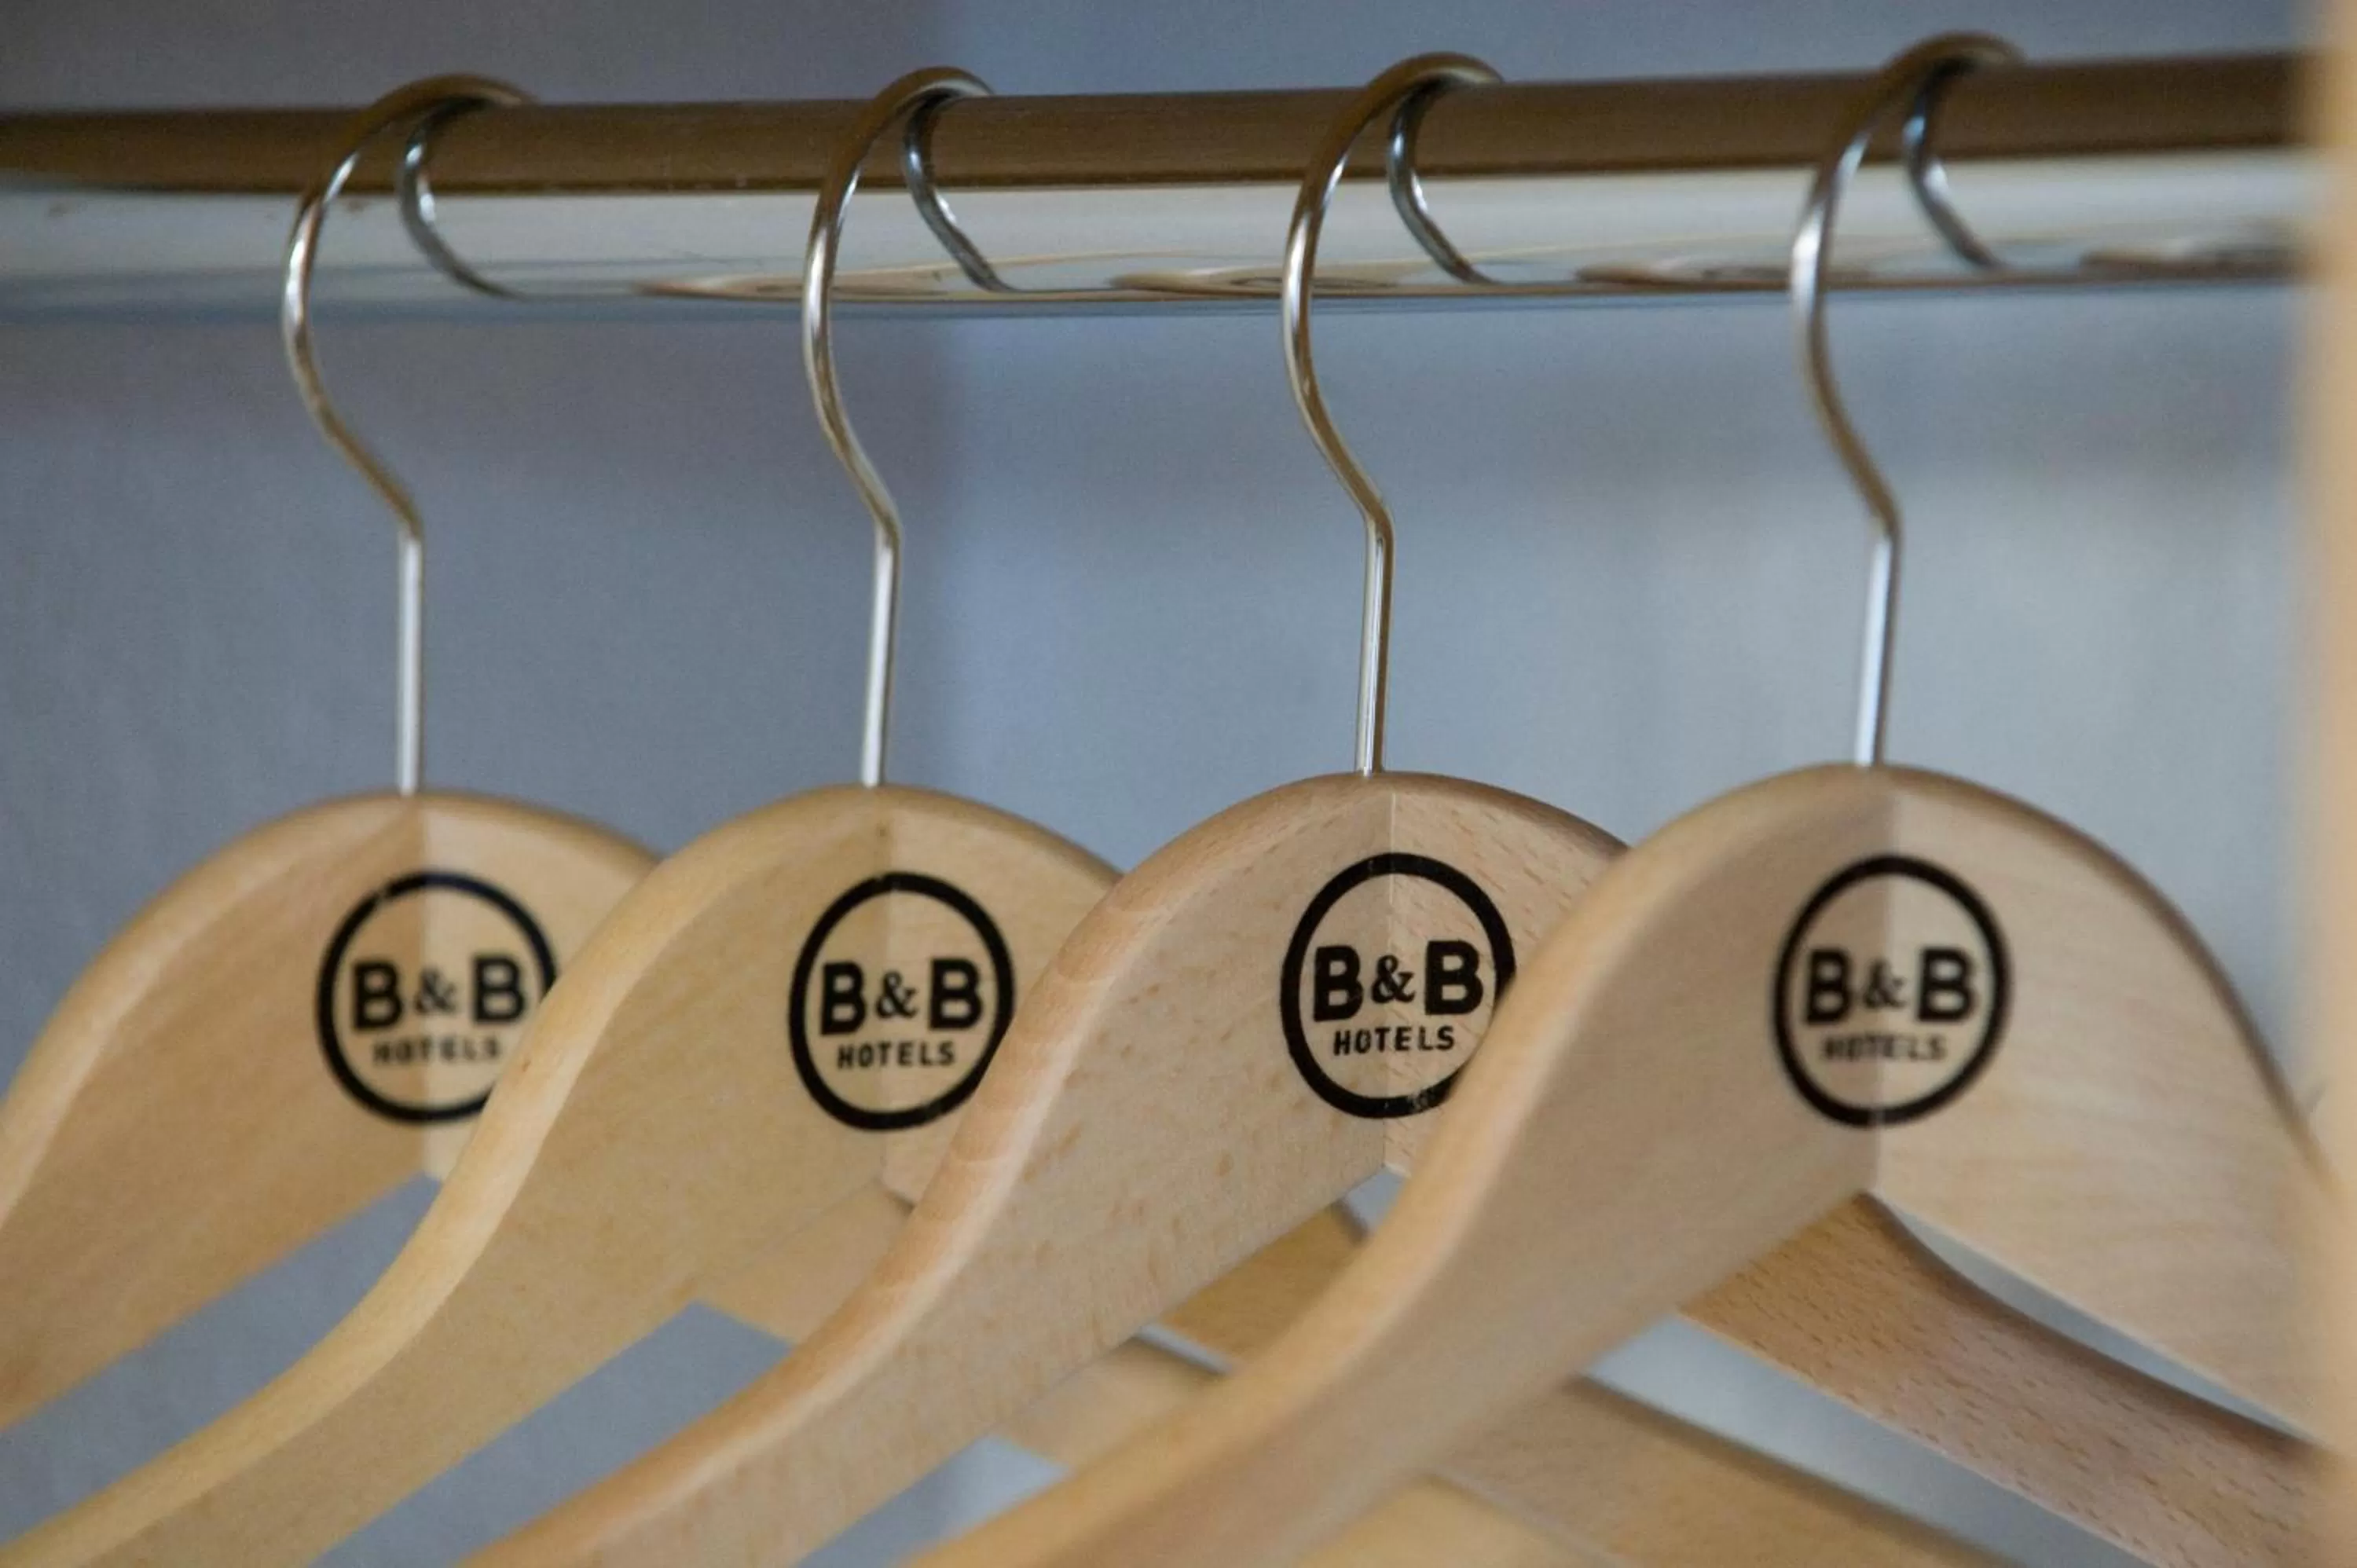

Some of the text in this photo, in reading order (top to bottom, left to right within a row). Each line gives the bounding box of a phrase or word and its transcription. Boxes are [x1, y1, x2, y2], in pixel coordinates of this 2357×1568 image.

[353, 954, 526, 1031] B&B
[819, 957, 983, 1036] B&B
[1313, 940, 1483, 1022] B&B
[1805, 947, 1978, 1026] B&B
[837, 1041, 955, 1069] HOTELS
[1332, 1025, 1455, 1056] HOTELS
